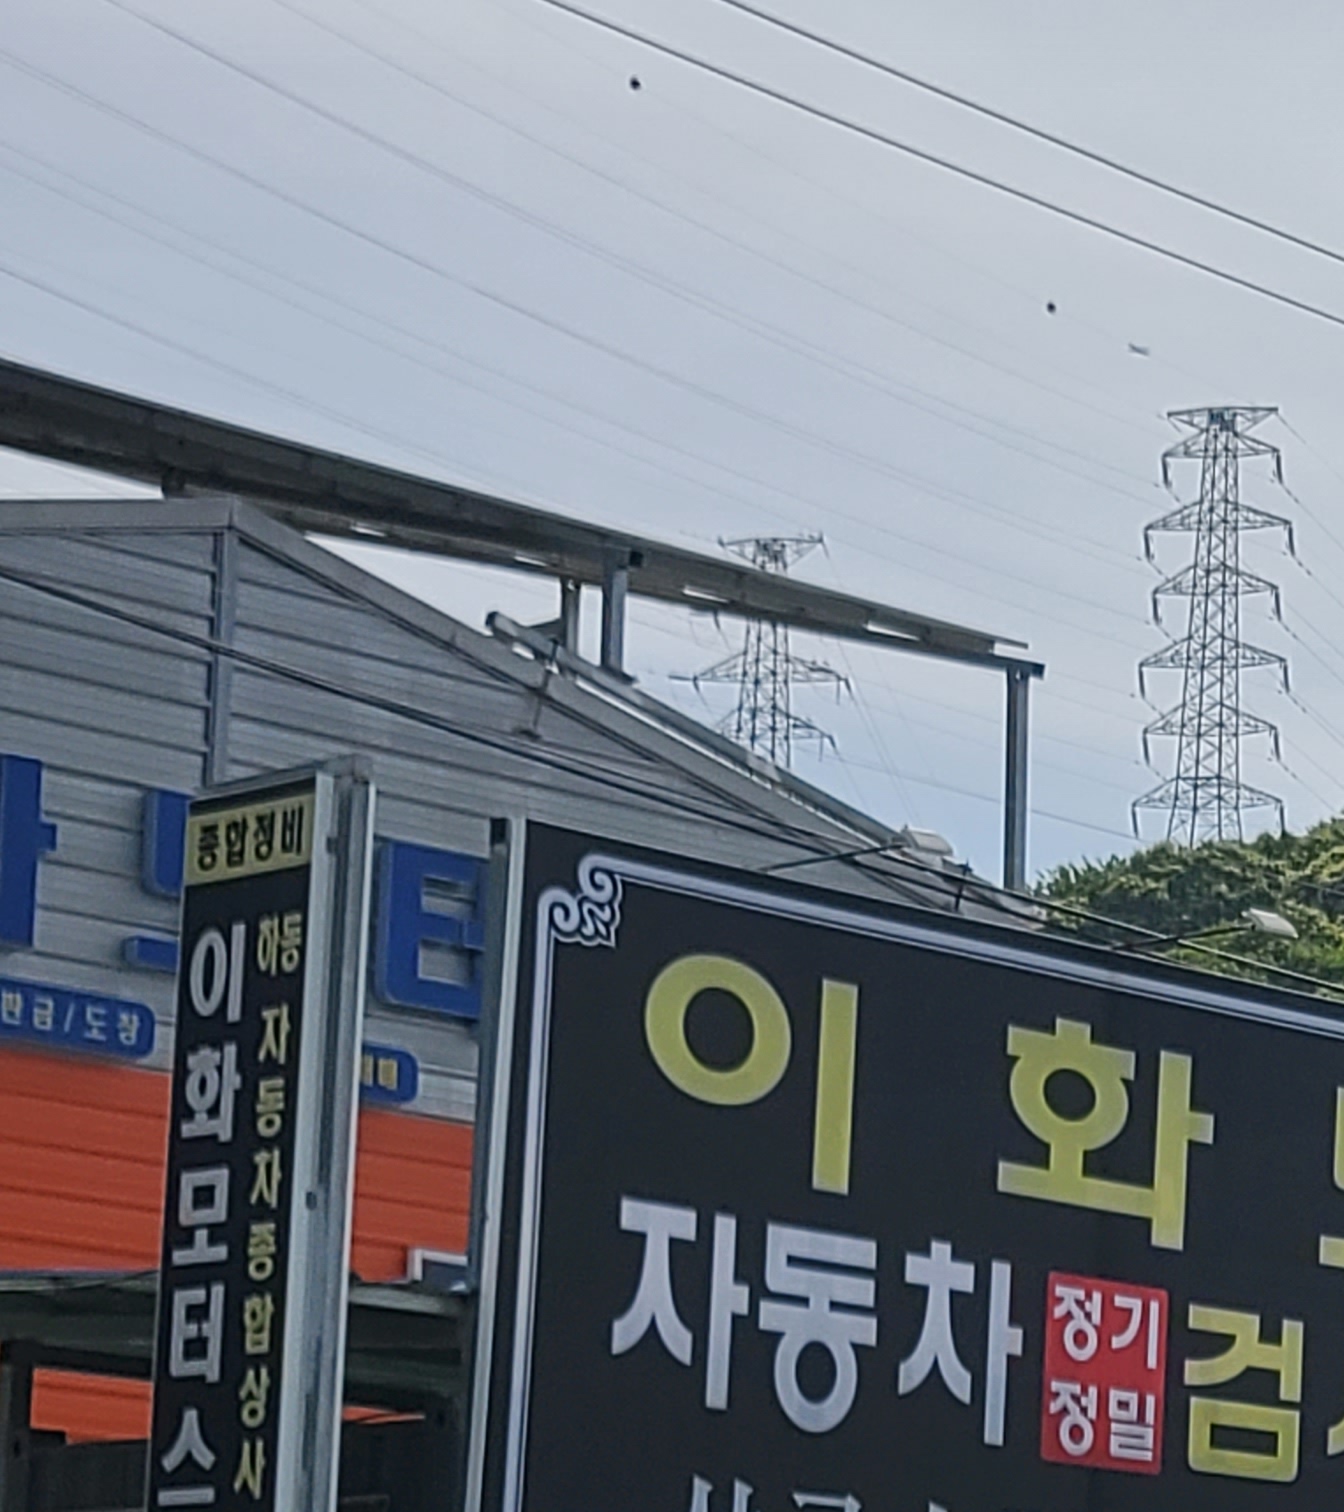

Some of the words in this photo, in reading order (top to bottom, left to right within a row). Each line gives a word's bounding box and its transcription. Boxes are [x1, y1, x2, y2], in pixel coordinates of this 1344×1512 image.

[197, 804, 304, 872] 종합정비
[256, 913, 302, 977] 하동
[157, 921, 247, 1507] 이화모터스
[233, 1003, 292, 1501] 자동차종합상사
[611, 1195, 1023, 1447] 자동차
[1053, 1283, 1160, 1370] 정기
[1049, 1378, 1156, 1462] 정밀
